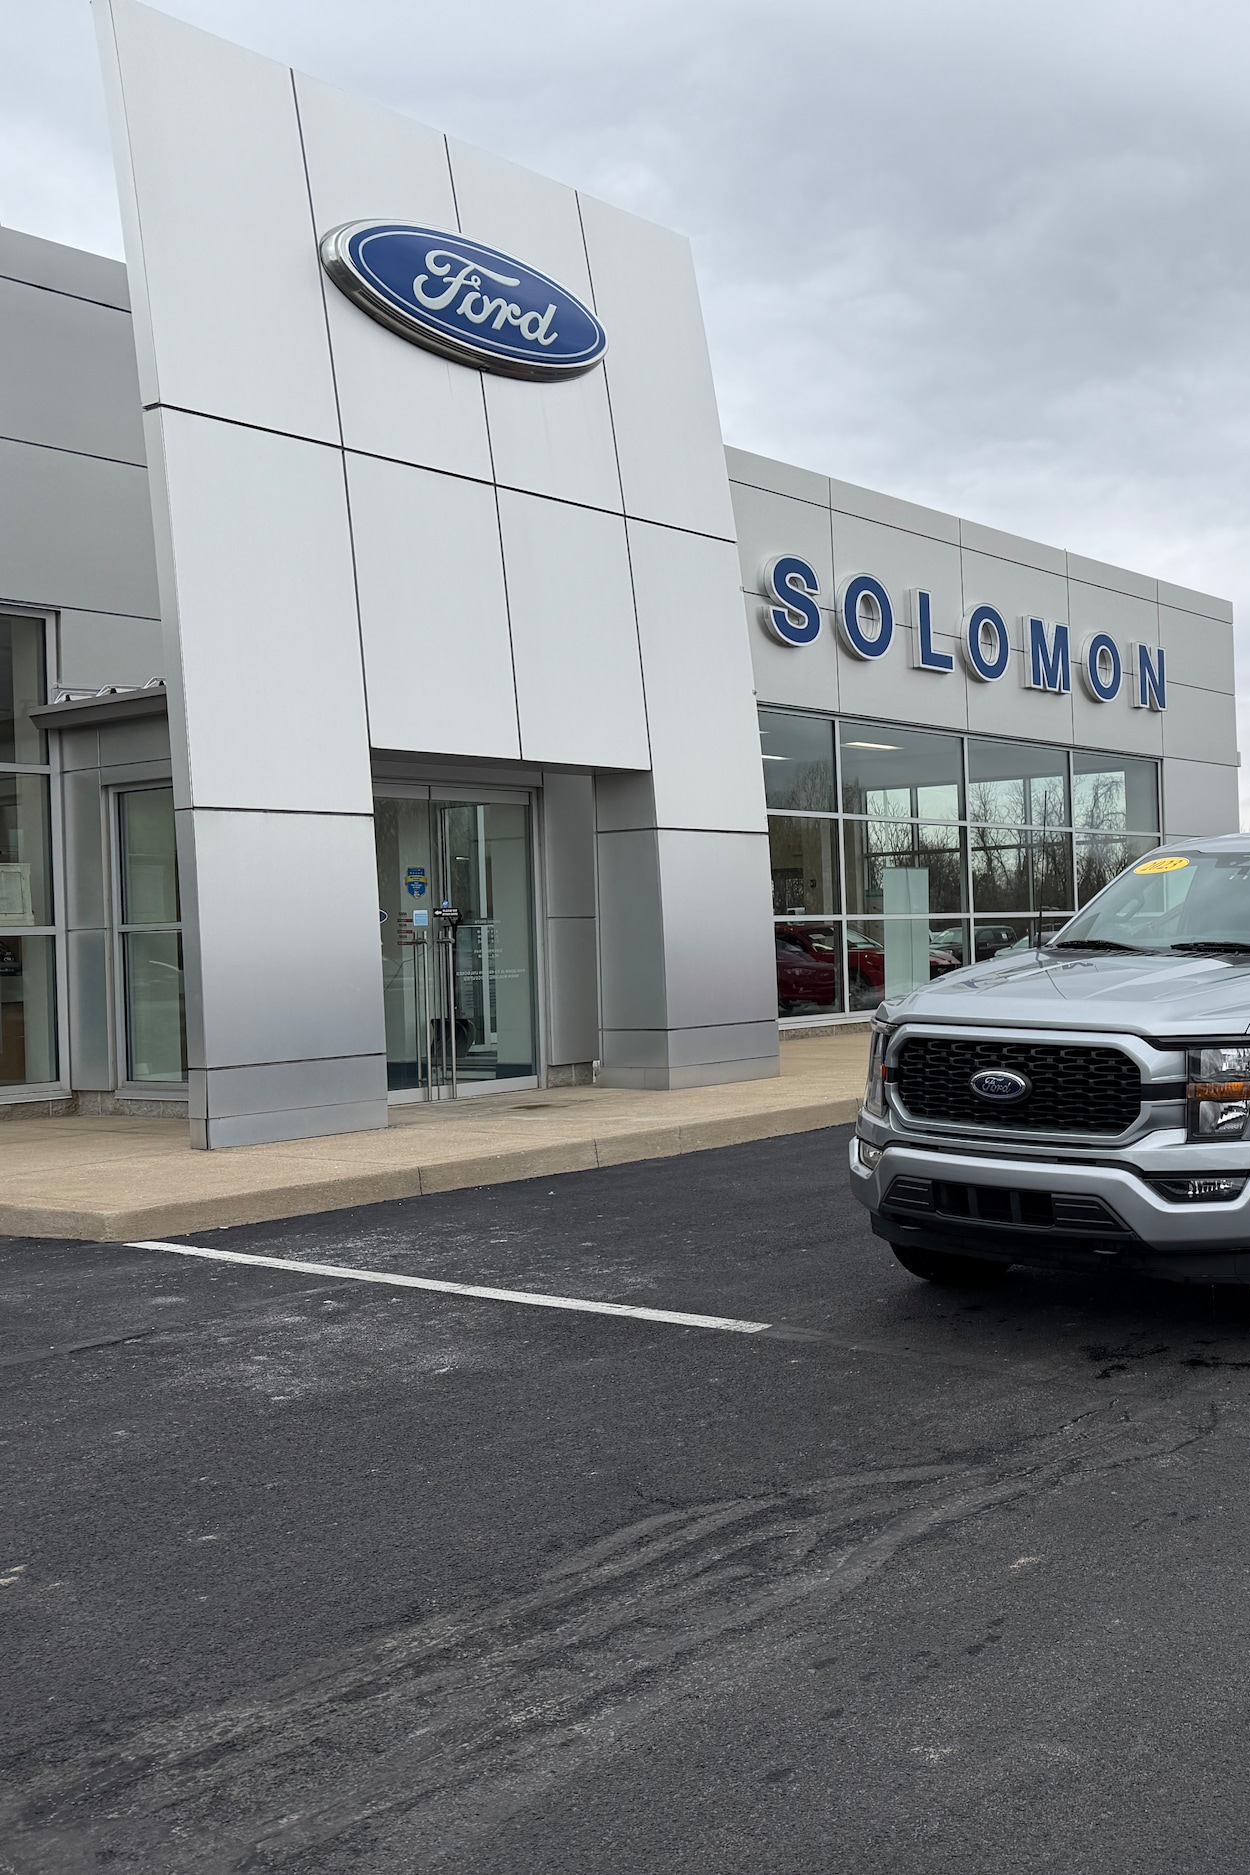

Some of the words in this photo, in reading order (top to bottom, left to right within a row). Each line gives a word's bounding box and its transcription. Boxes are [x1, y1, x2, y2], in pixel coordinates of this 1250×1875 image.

[412, 249, 559, 346] Ford
[763, 554, 1168, 711] SOLOMON
[1140, 859, 1184, 872] 2023
[981, 1076, 1012, 1094] Ford
